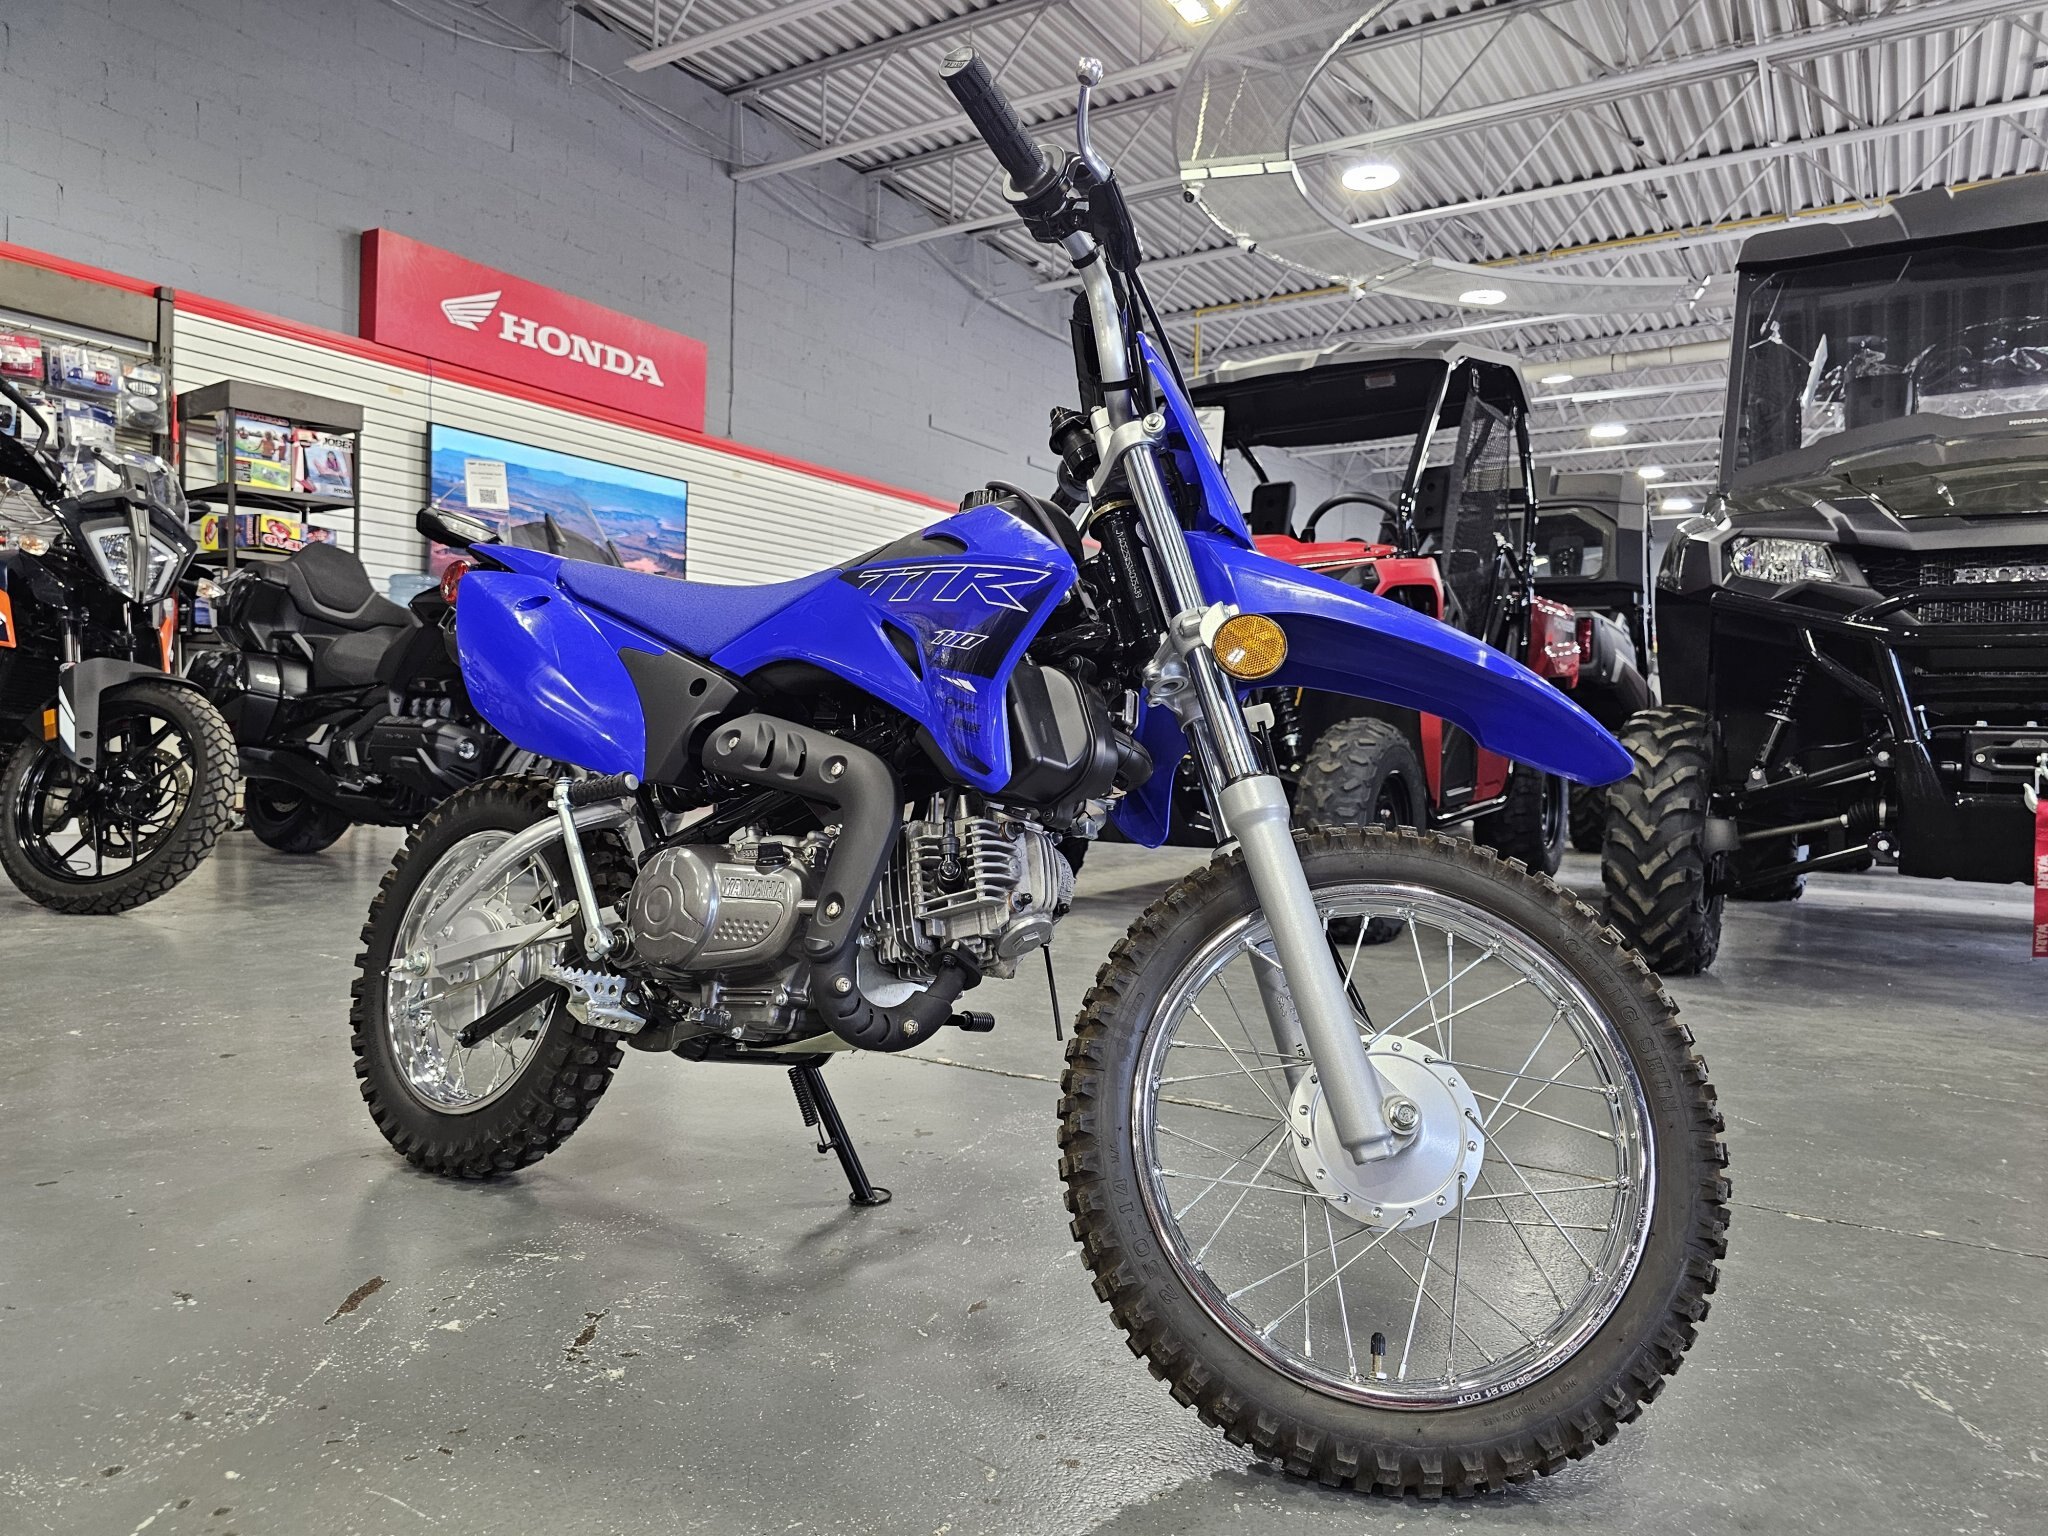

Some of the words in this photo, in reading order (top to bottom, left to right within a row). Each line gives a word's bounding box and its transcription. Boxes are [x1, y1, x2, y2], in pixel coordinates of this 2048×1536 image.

[499, 311, 664, 388] HONDA
[857, 563, 1052, 612] TTR
[931, 629, 989, 650] 110
[723, 877, 785, 899] YAMAHA
[1561, 934, 1641, 1025] CHENG
[1636, 1036, 1680, 1113] SHIN
[1112, 1177, 1180, 1305] 2.50-14
[1457, 1391, 1482, 1405] DOT
